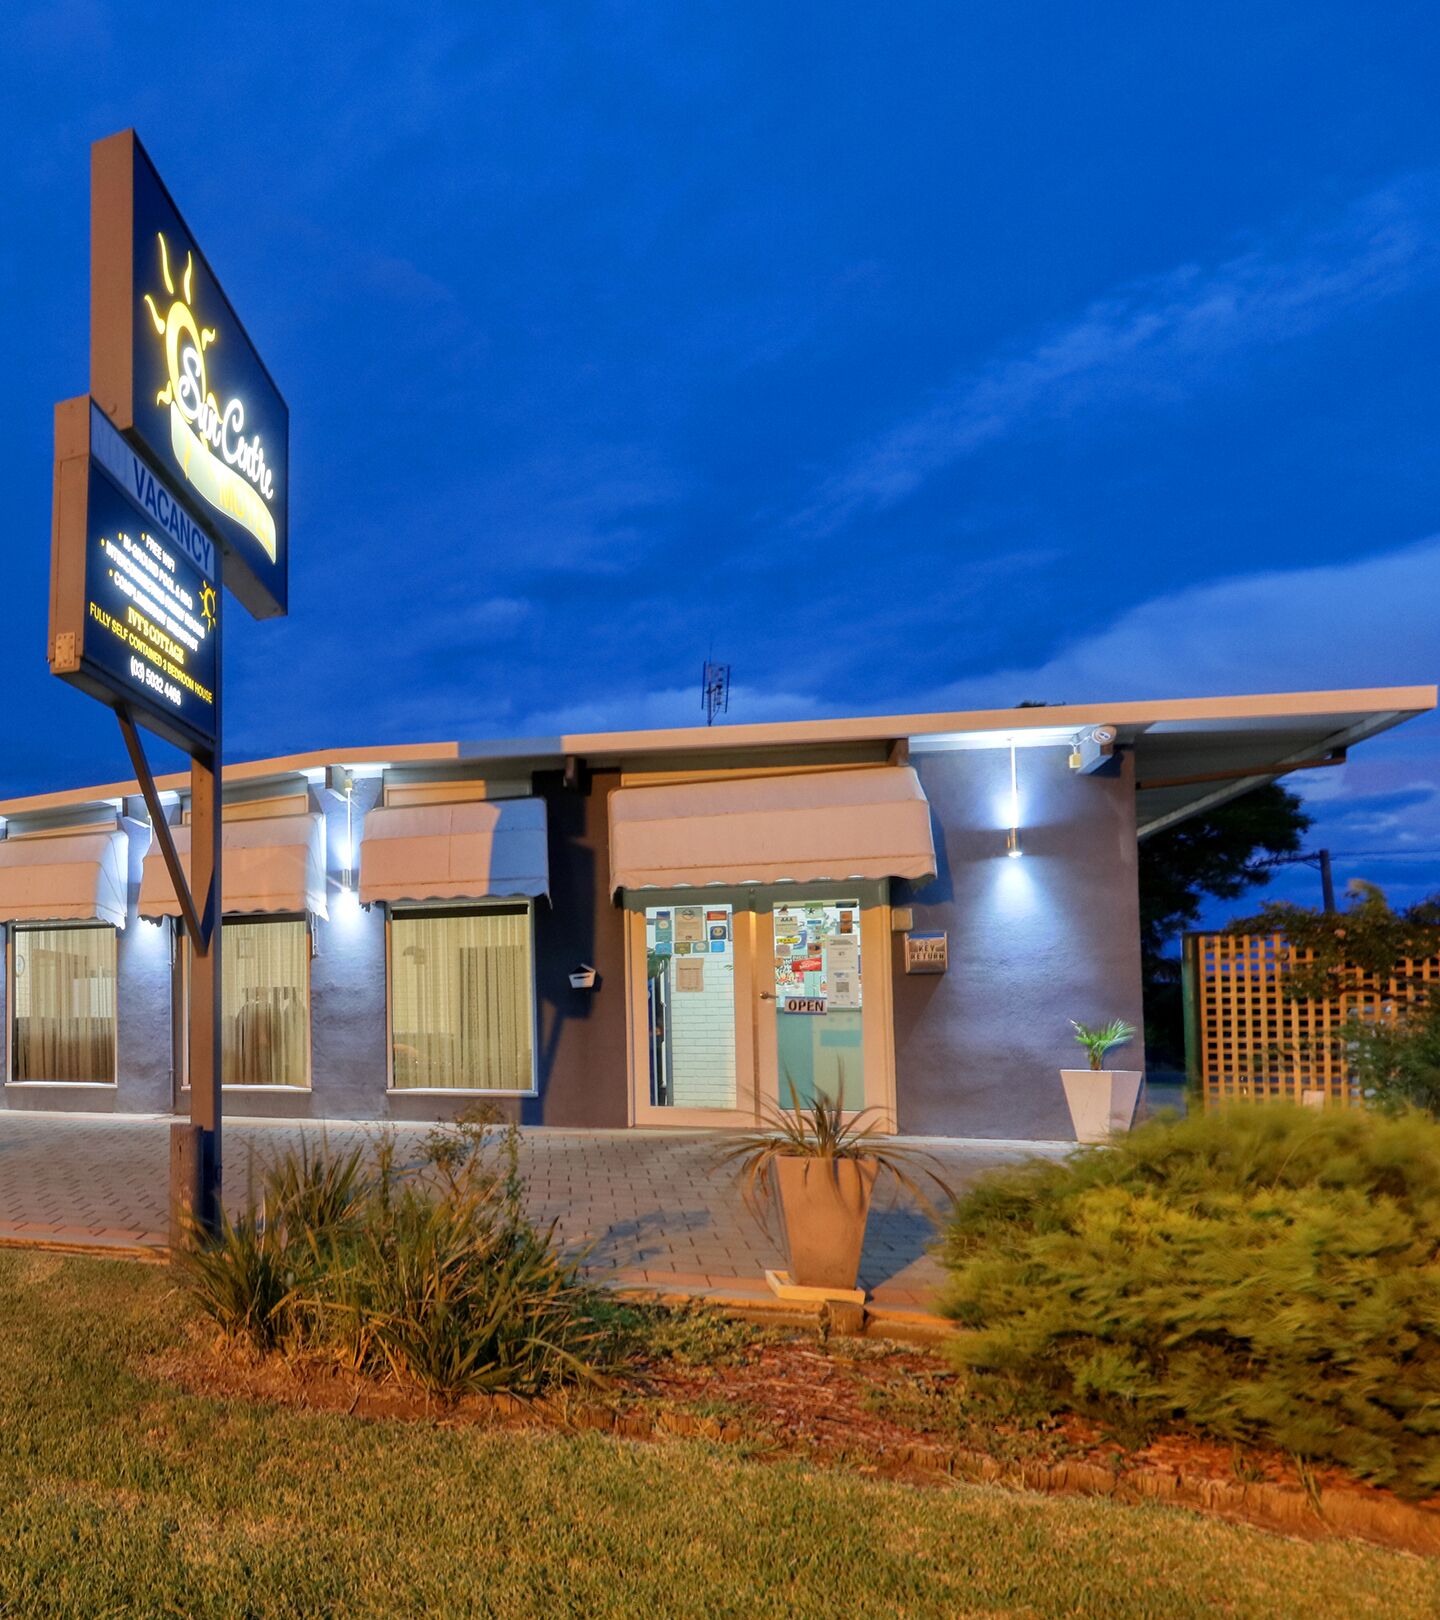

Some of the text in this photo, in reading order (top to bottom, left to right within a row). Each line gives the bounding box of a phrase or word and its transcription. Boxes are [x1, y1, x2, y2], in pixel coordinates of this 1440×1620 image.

[178, 347, 274, 500] Sun Centre
[133, 456, 211, 571] VACANCY
[146, 534, 162, 561] FREE
[90, 601, 111, 628] FULLY
[111, 619, 128, 640] SELF
[129, 633, 162, 667] CONTAINED
[167, 661, 195, 691] BEDROOM
[194, 681, 213, 704] HOUSE
[149, 625, 184, 664] COTTAGE
[130, 655, 145, 683] (03)
[146, 668, 164, 694] 5032
[910, 952, 944, 960] RETURN
[788, 999, 824, 1012] OPEN
